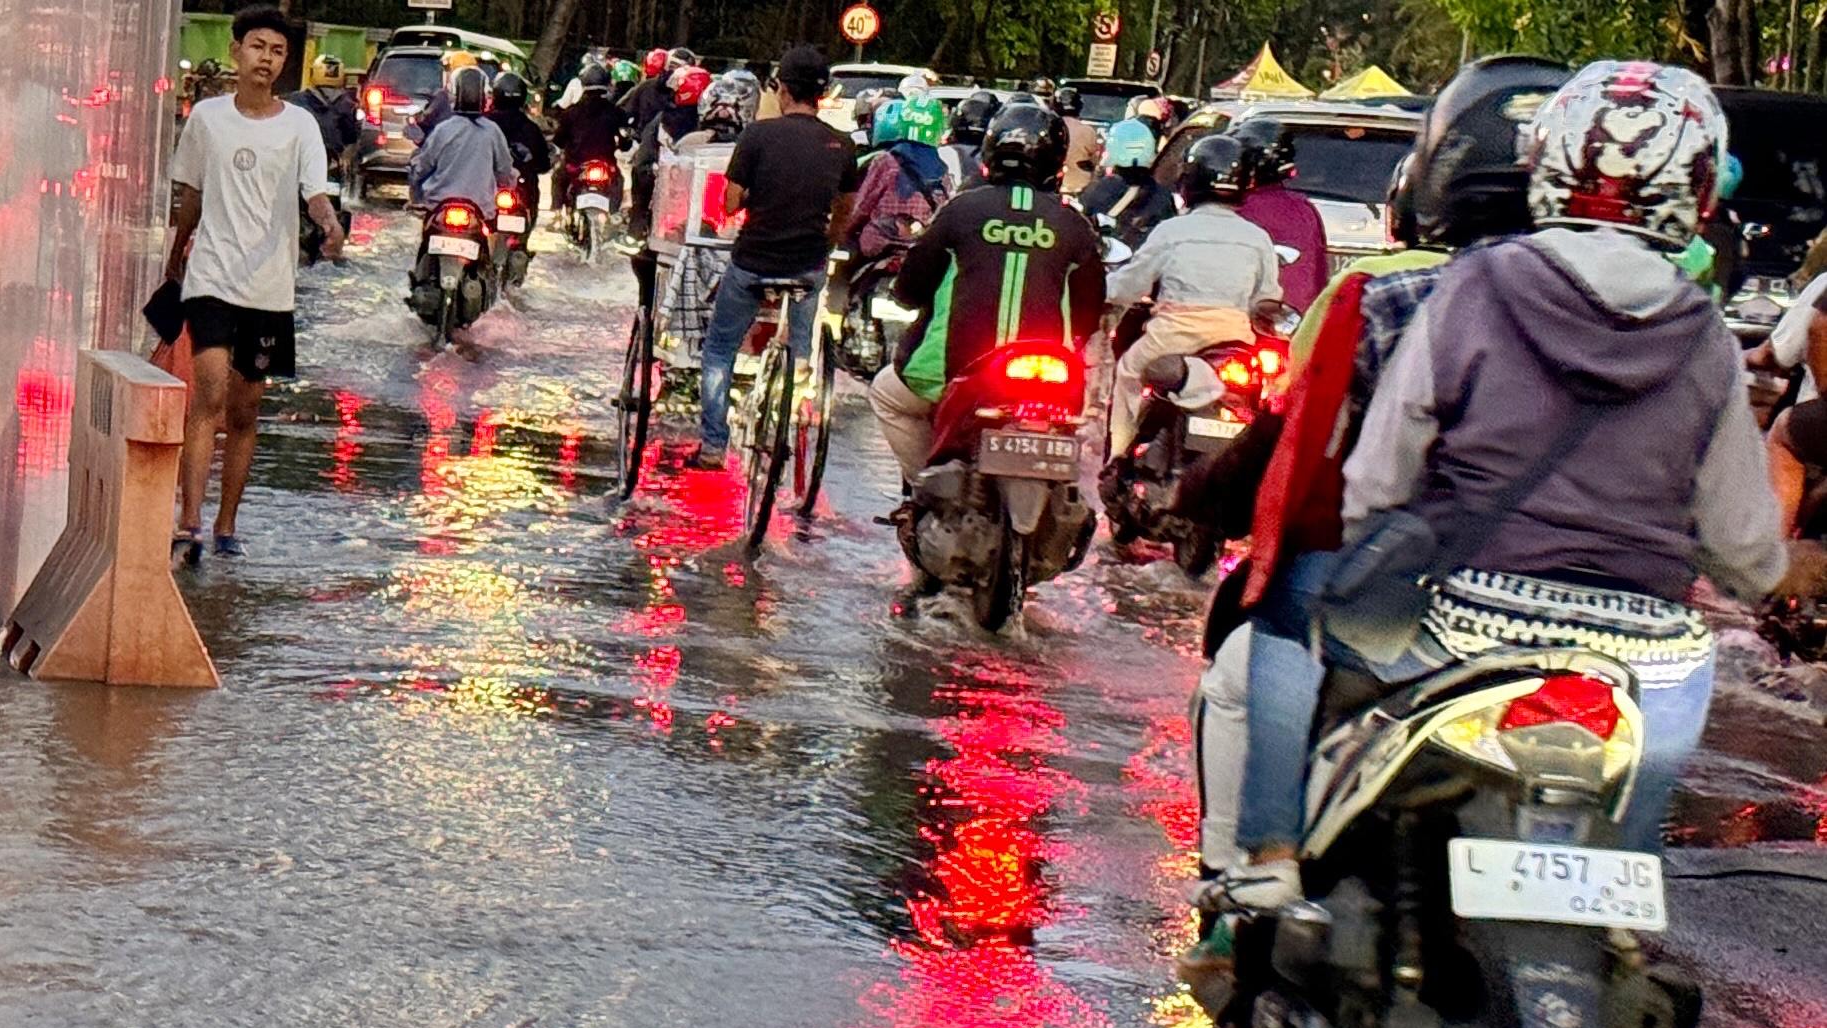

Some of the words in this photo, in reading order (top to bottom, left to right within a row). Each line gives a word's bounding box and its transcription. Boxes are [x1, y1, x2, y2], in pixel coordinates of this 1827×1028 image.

[847, 16, 865, 35] 40
[901, 107, 934, 126] Grab
[982, 218, 1055, 249] Grab
[989, 437, 999, 452] S
[1467, 848, 1486, 875] L
[1511, 850, 1591, 883] 4757
[1613, 858, 1652, 888] JG
